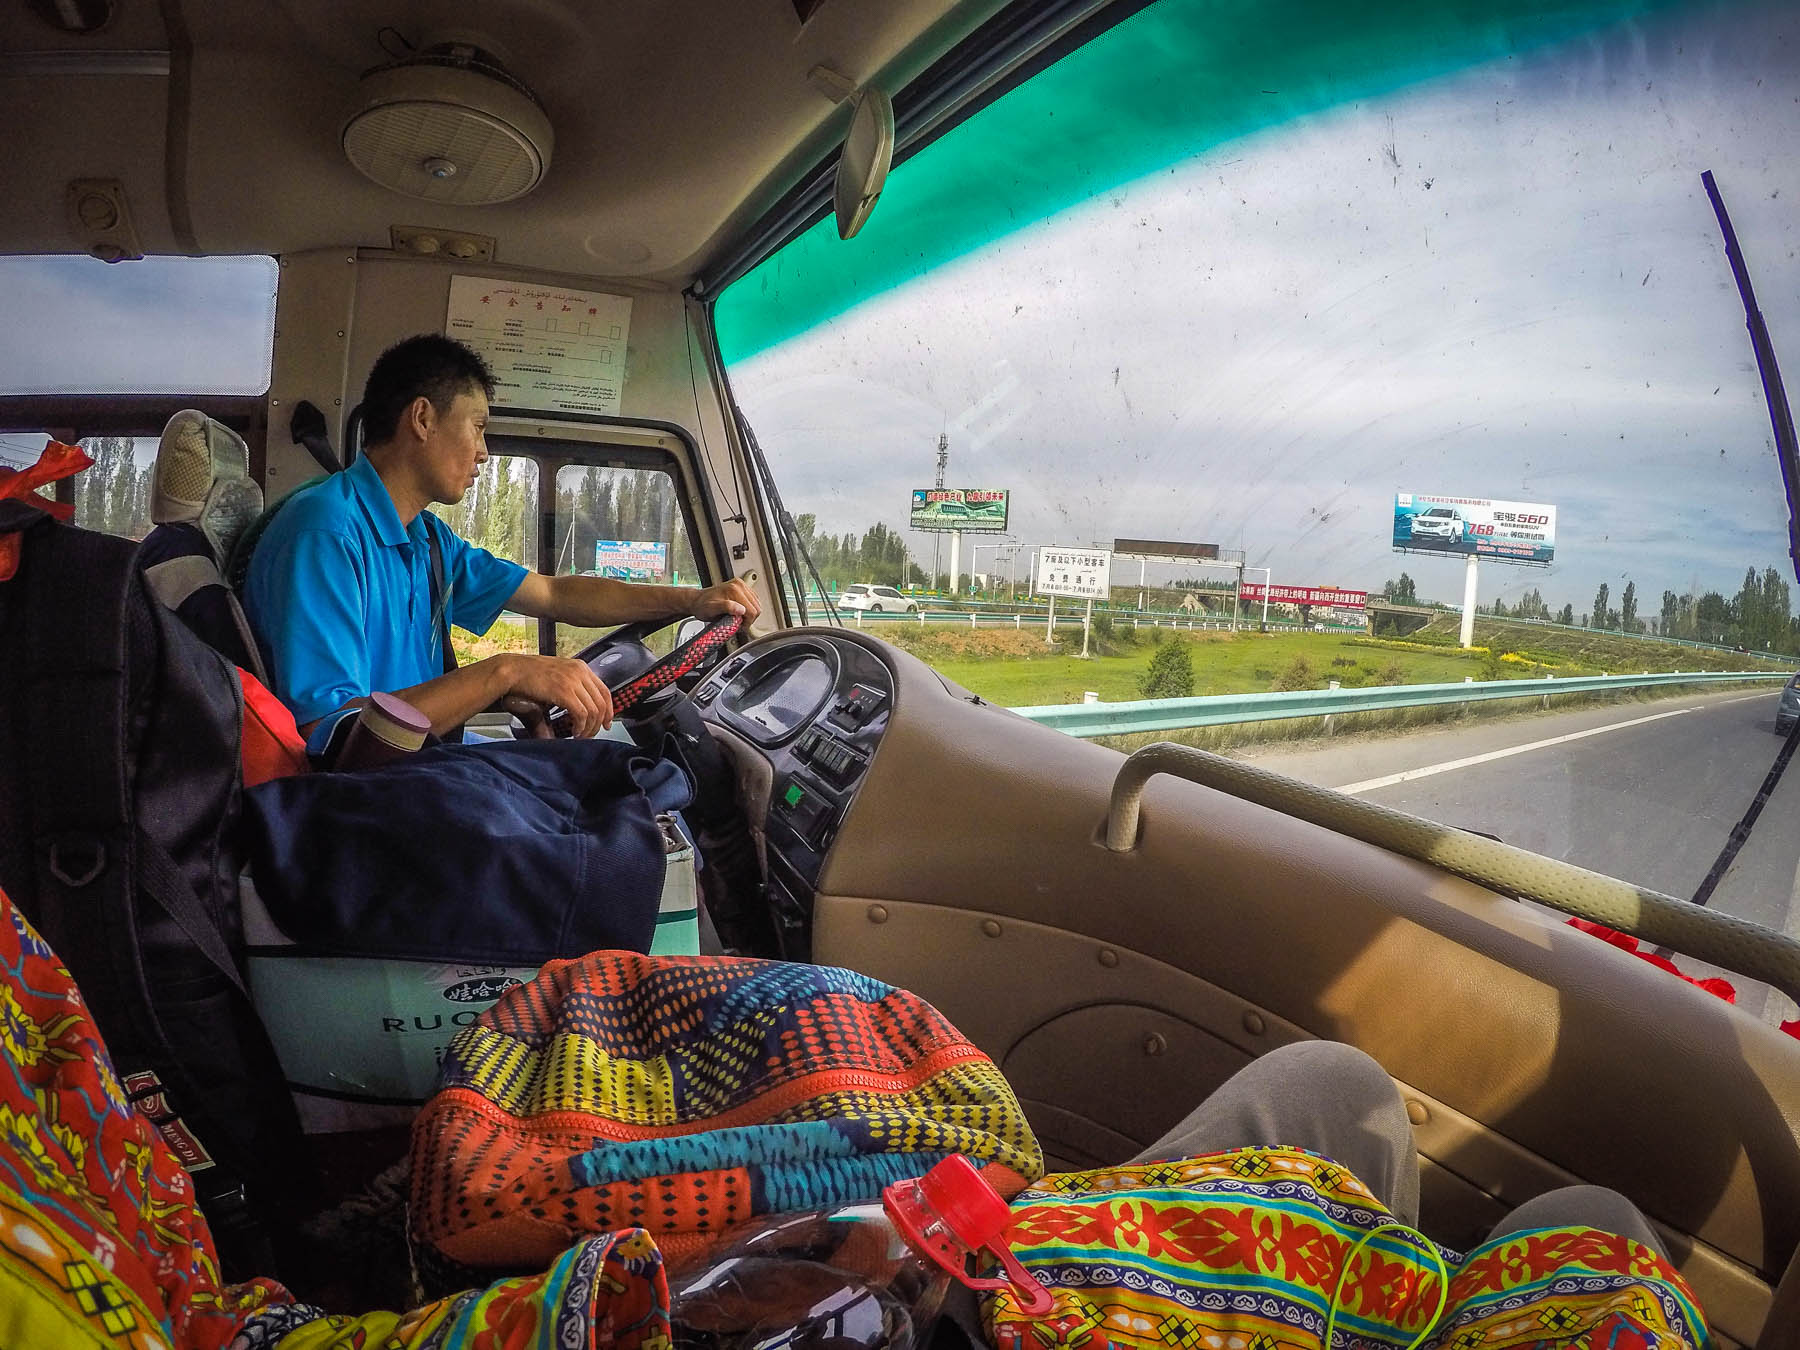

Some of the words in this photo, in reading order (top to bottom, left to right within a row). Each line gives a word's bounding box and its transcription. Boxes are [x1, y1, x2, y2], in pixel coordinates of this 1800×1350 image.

[1493, 510, 1550, 526] 宝骏560
[1044, 554, 1106, 568] 7座及以下小型客车
[1048, 573, 1097, 586] 免费通行
[1309, 590, 1366, 605] 新疆向西开放的重要窗口
